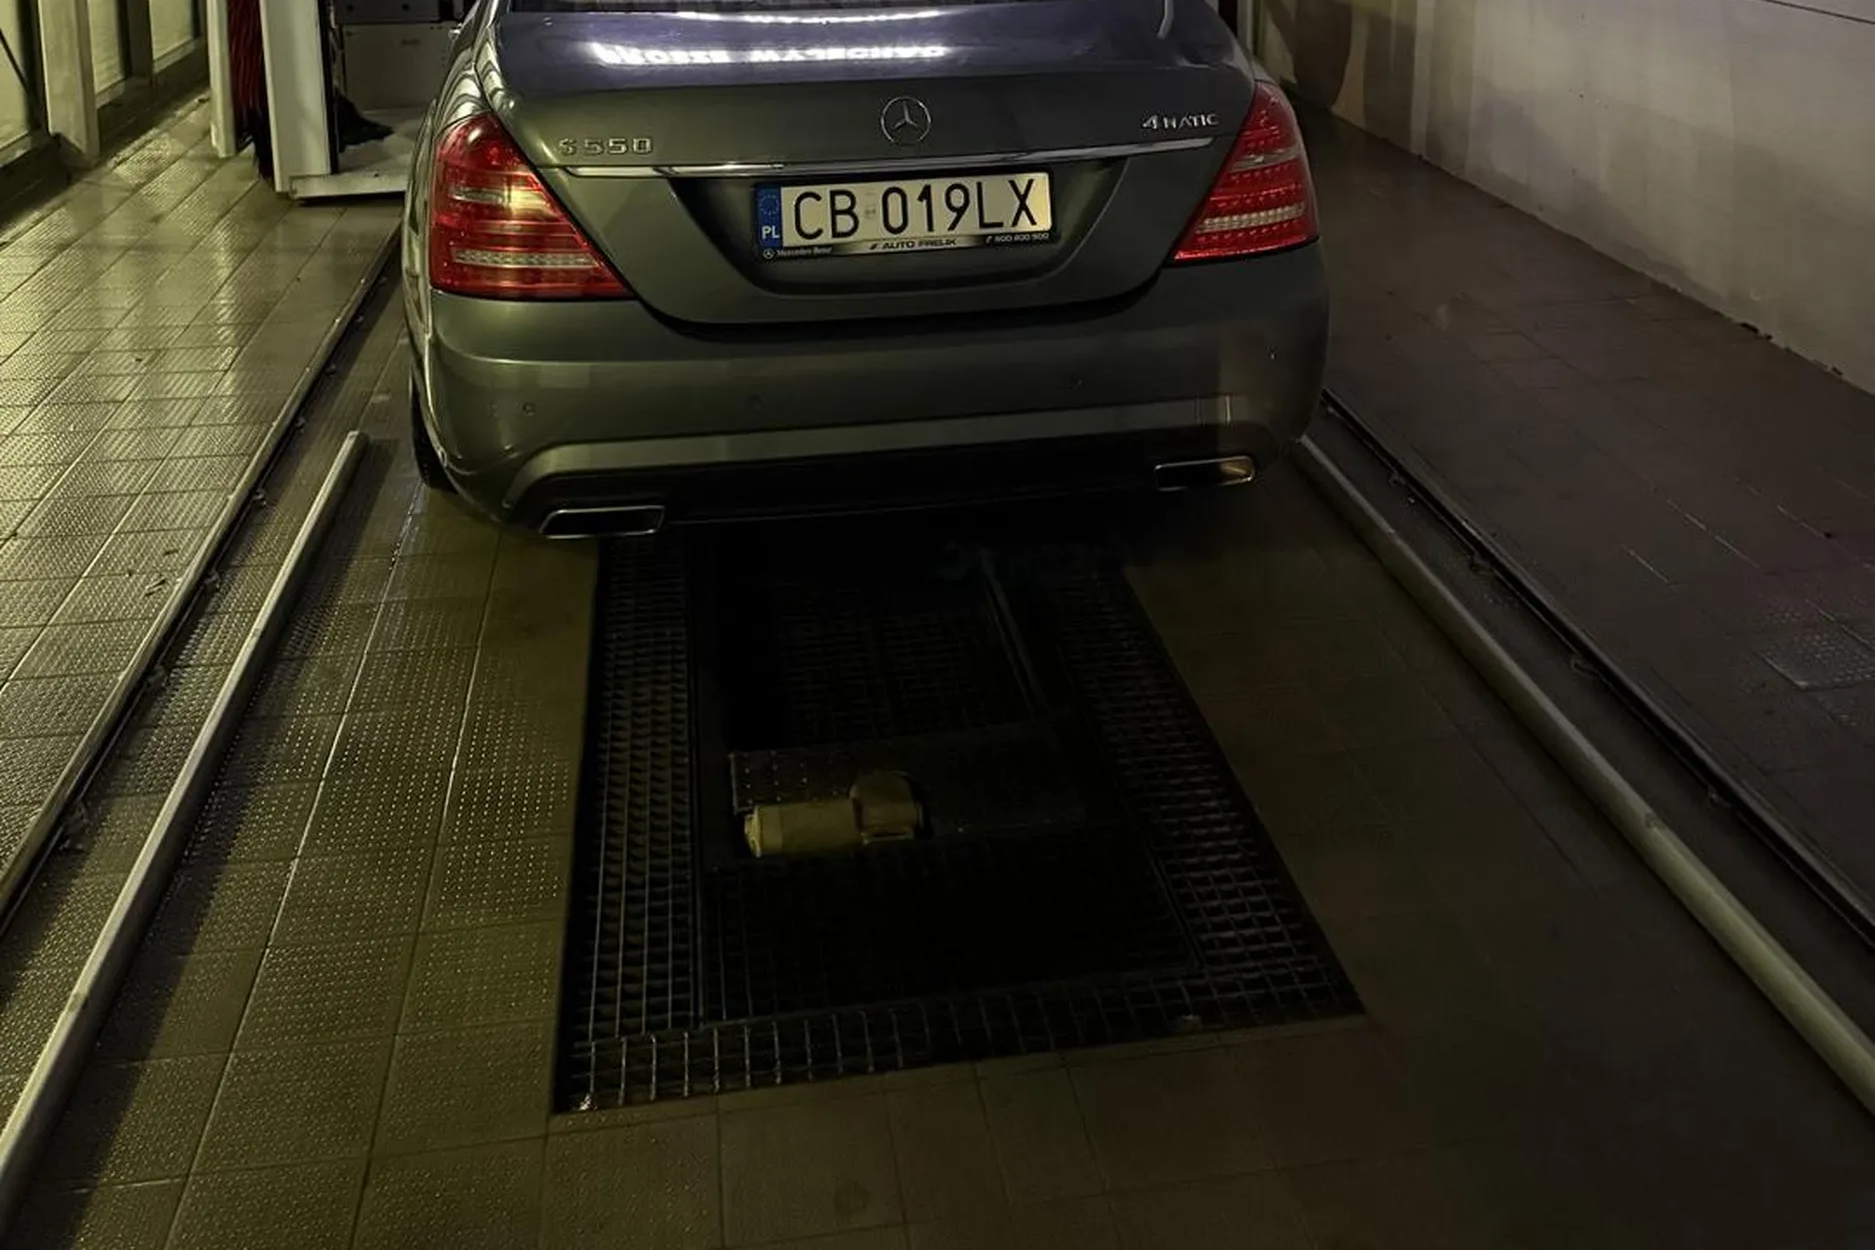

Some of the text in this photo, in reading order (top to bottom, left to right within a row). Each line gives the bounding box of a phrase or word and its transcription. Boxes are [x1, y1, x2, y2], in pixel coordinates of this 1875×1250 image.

[793, 178, 1037, 241] CB 019LX
[761, 225, 781, 240] PL
